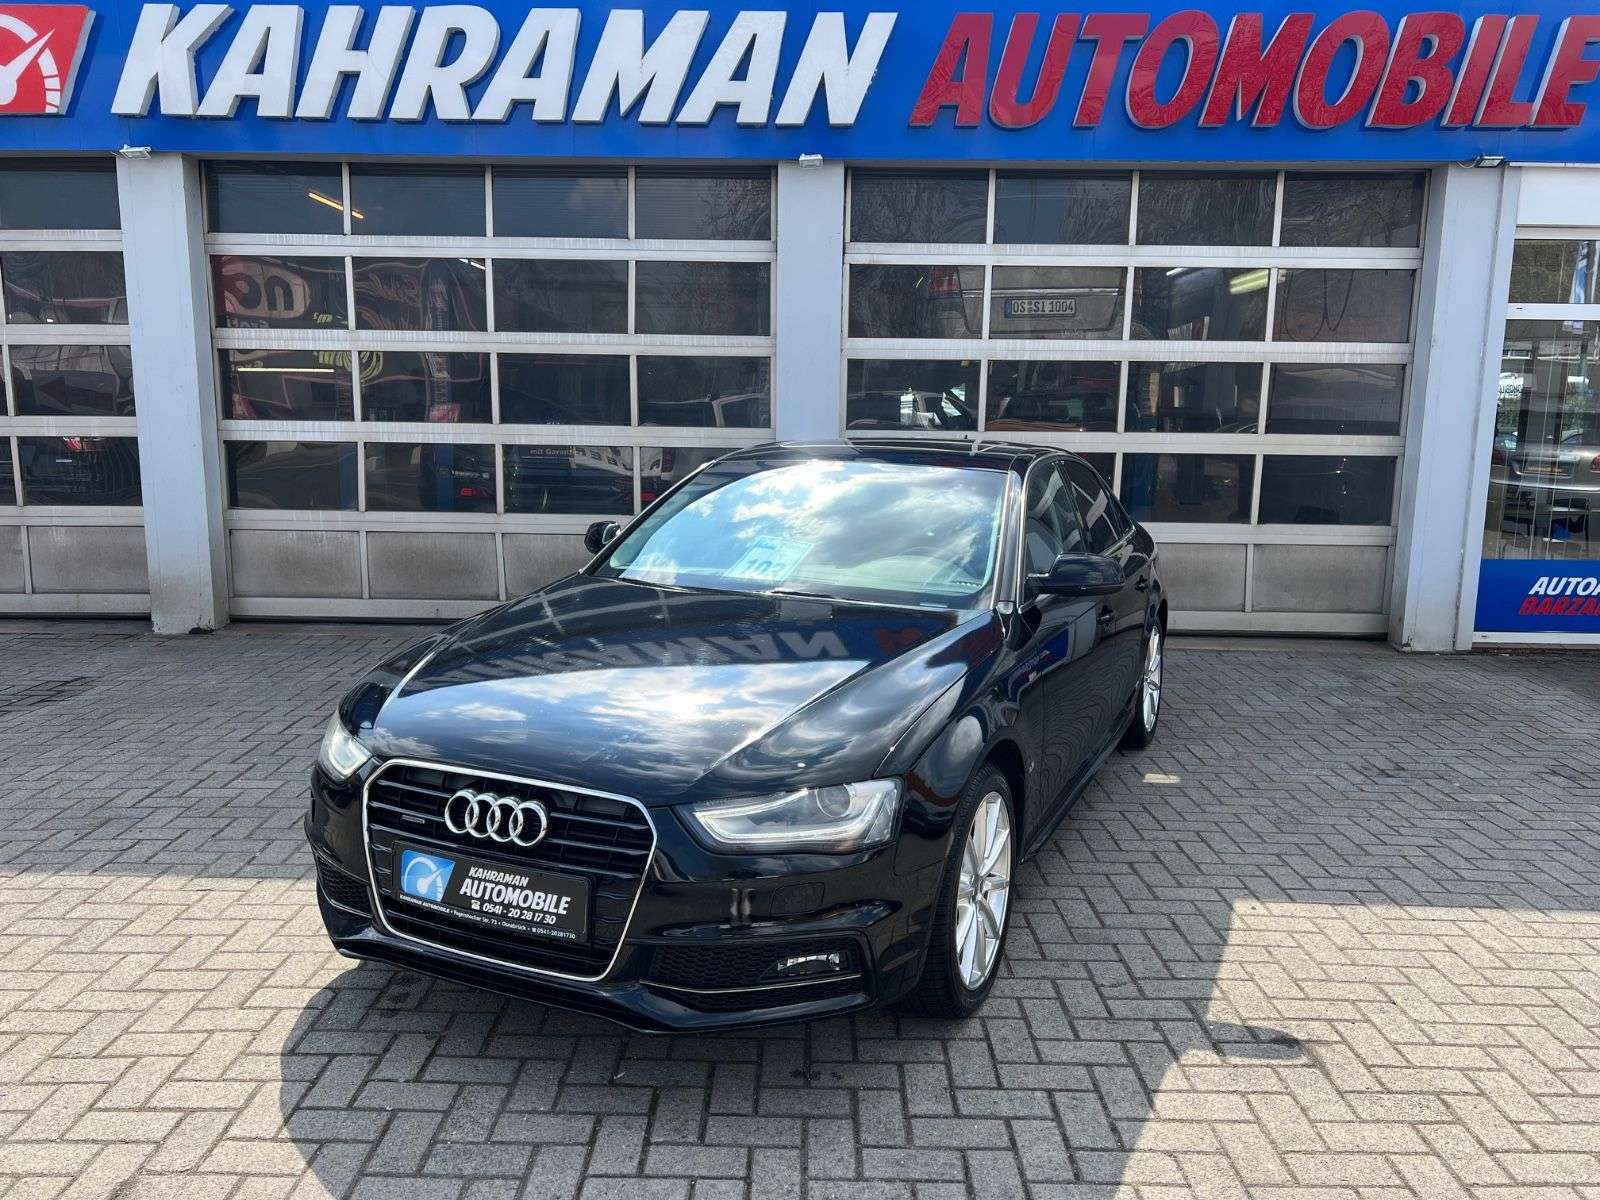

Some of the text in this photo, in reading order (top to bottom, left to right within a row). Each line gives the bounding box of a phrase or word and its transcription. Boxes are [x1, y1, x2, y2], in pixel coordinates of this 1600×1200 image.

[111, 3, 1600, 130] KAHRAMAN AUTOMOBILE
[1012, 300, 1026, 313] OS
[1048, 300, 1074, 313] 1004
[1528, 576, 1600, 596] AUTO
[1518, 596, 1600, 617] BARZA
[468, 866, 529, 887] KAHRAMAN
[459, 878, 571, 915] AUTOMOBILE
[482, 902, 503, 914] 0541
[508, 908, 521, 918] 20
[520, 910, 533, 920] 28
[543, 914, 557, 925] 30
